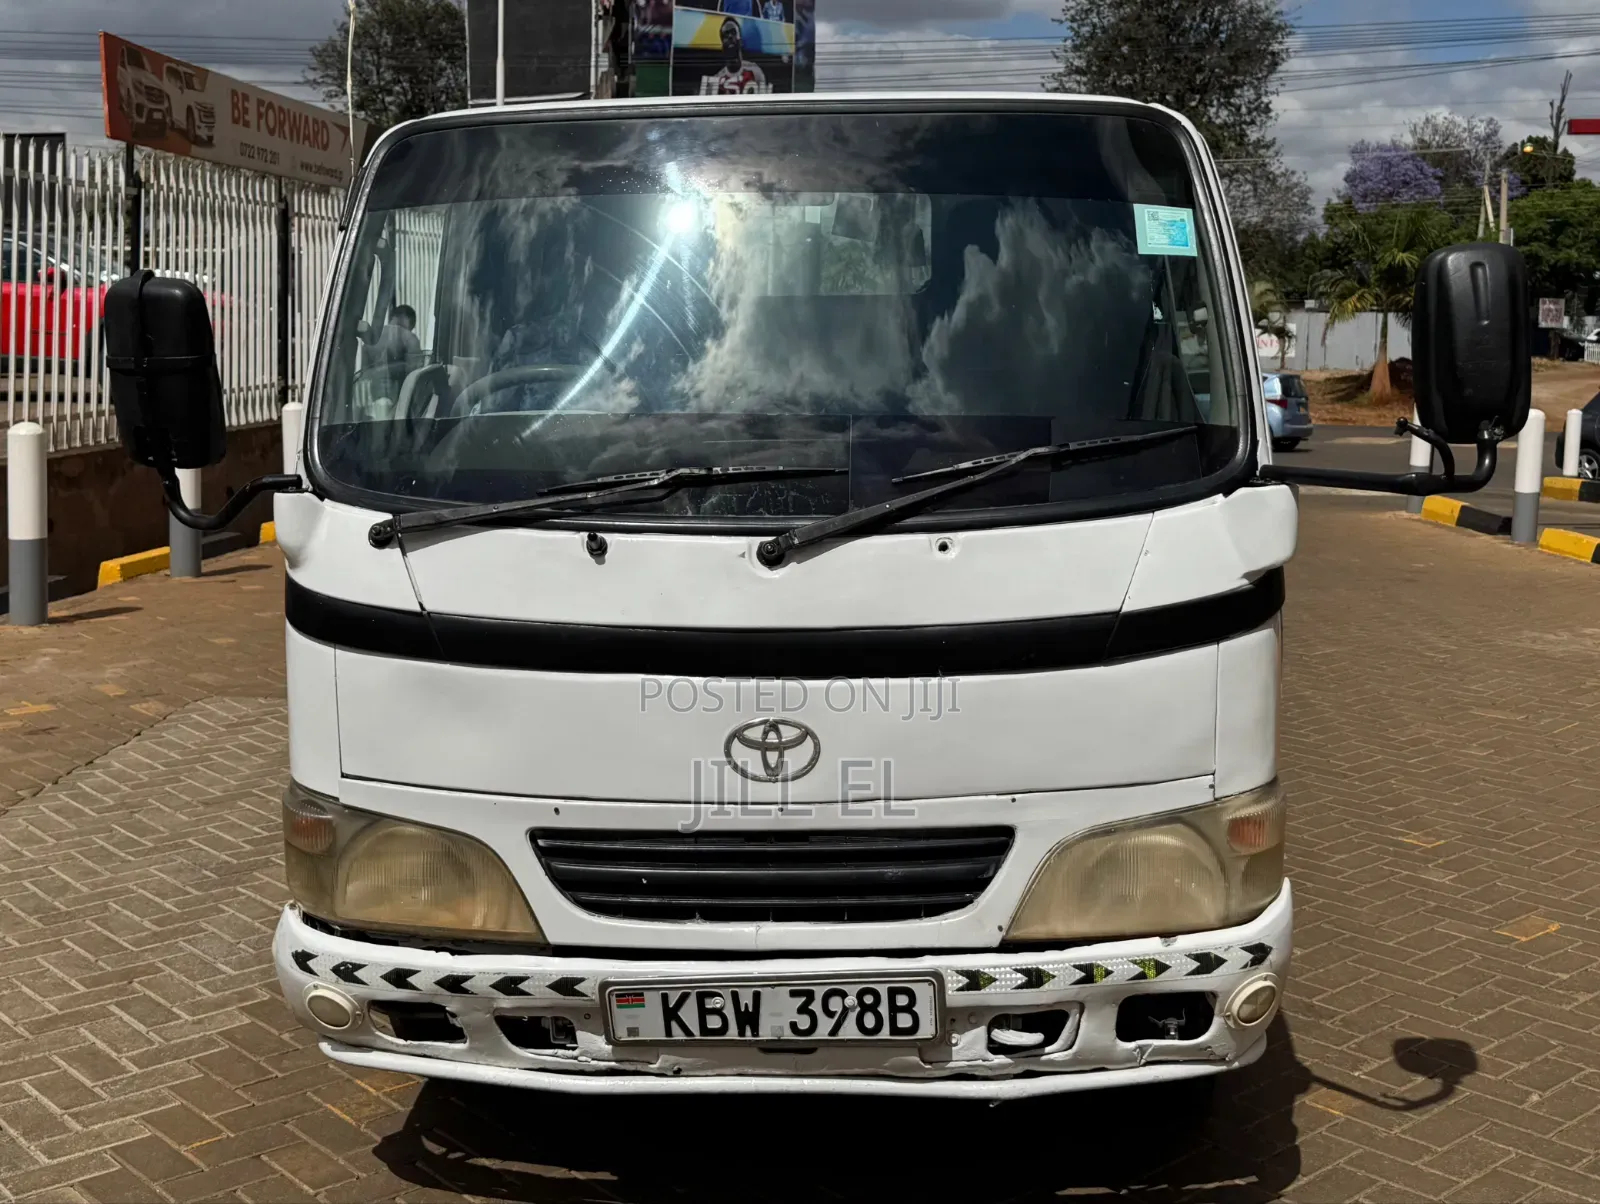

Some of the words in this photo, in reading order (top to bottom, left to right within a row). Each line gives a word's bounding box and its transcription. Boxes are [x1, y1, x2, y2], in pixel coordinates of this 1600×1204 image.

[230, 88, 250, 128] BE
[256, 98, 330, 152] FORWARD
[660, 989, 762, 1038] KBW
[788, 985, 921, 1037] 398B
